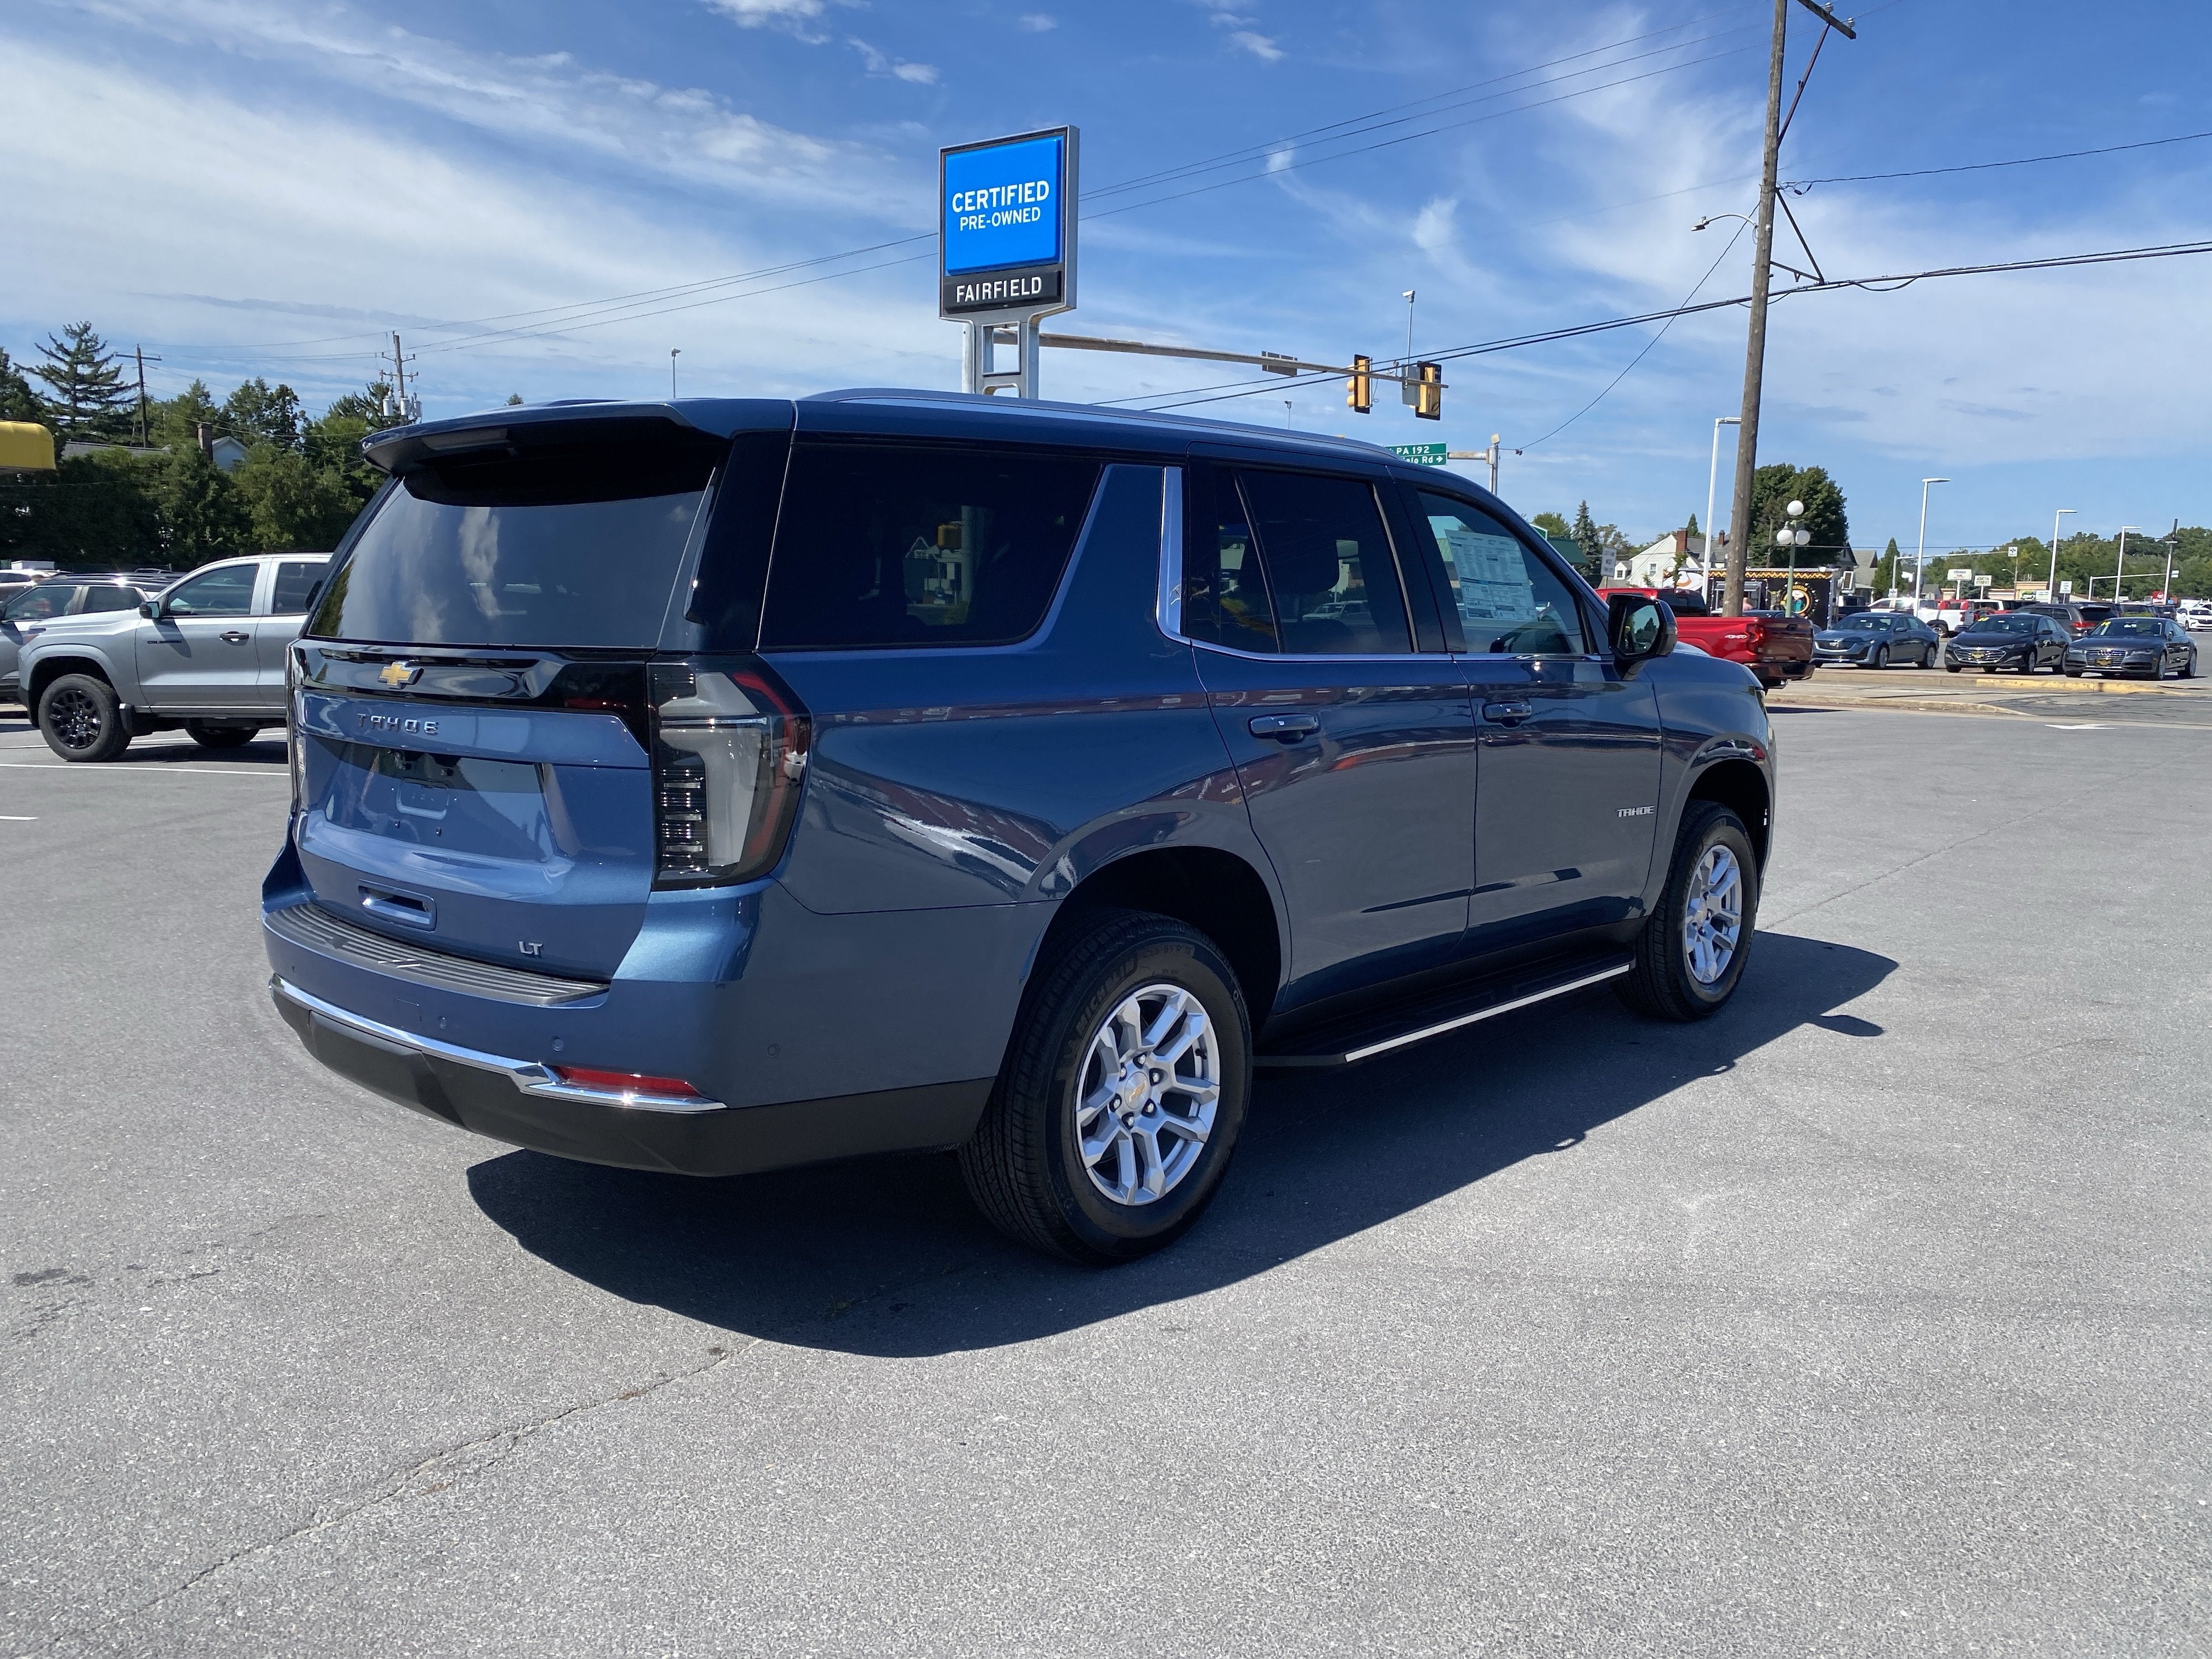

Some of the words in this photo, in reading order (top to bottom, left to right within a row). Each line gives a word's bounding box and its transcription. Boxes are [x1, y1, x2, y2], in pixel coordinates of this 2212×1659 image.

[952, 180, 1049, 213] CERTIFIED
[960, 206, 1041, 232] PRE-OWNED
[956, 276, 1042, 303] FAIRFIELD
[1412, 445, 1429, 454] 192
[357, 713, 439, 736] TAHOE
[1616, 805, 1655, 818] TAHOE
[518, 940, 543, 956] LT
